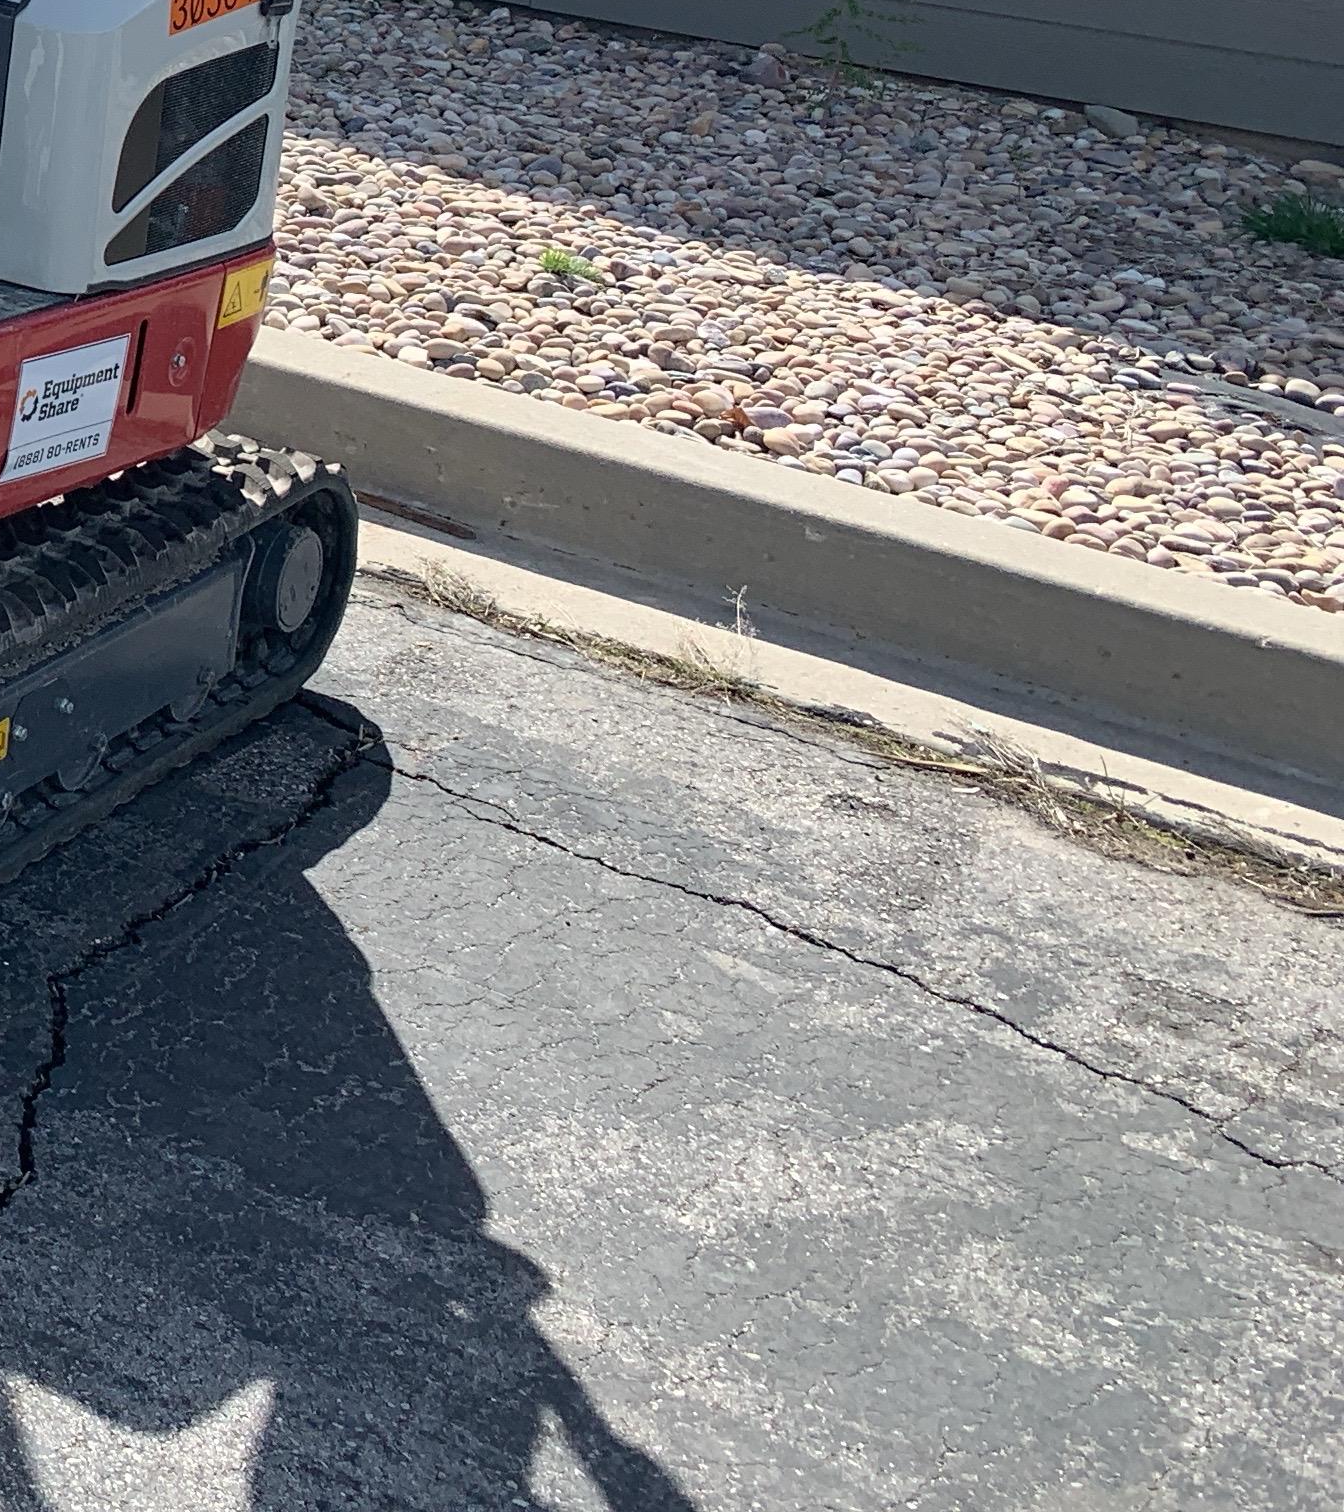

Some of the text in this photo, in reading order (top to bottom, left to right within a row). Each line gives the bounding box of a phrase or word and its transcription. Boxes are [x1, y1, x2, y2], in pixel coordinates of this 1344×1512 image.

[42, 363, 120, 400] Equipment
[38, 397, 80, 421] Share
[13, 433, 100, 470] (888) 80-RENTS
